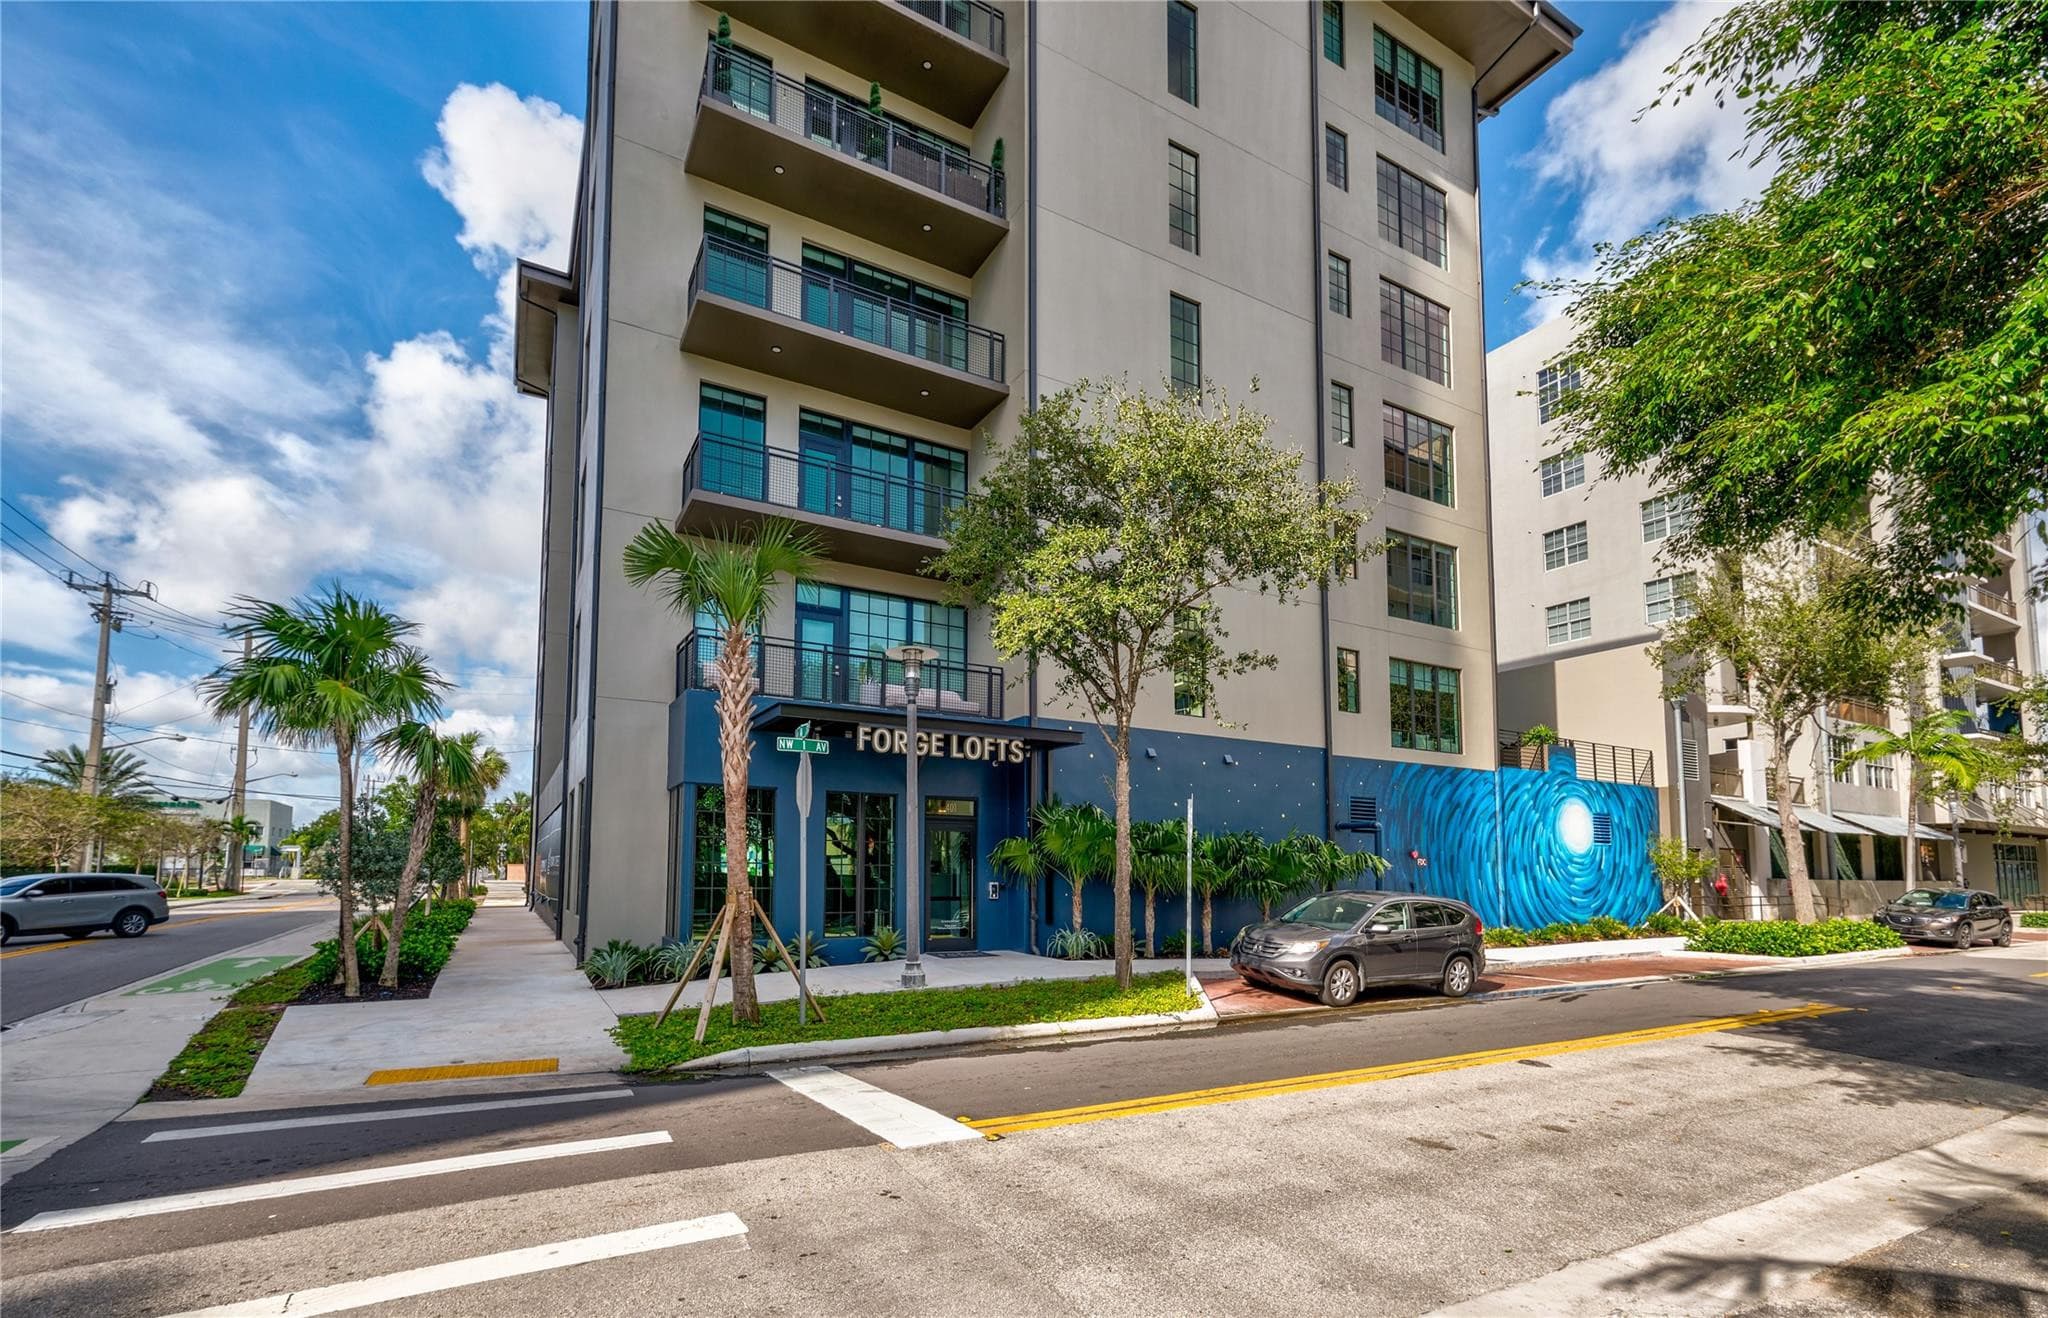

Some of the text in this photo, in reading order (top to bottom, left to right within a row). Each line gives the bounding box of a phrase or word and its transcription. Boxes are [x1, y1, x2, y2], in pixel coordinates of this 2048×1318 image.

[779, 739, 827, 752] NW 1 AV
[857, 725, 1025, 764] FORGE LOFTS
